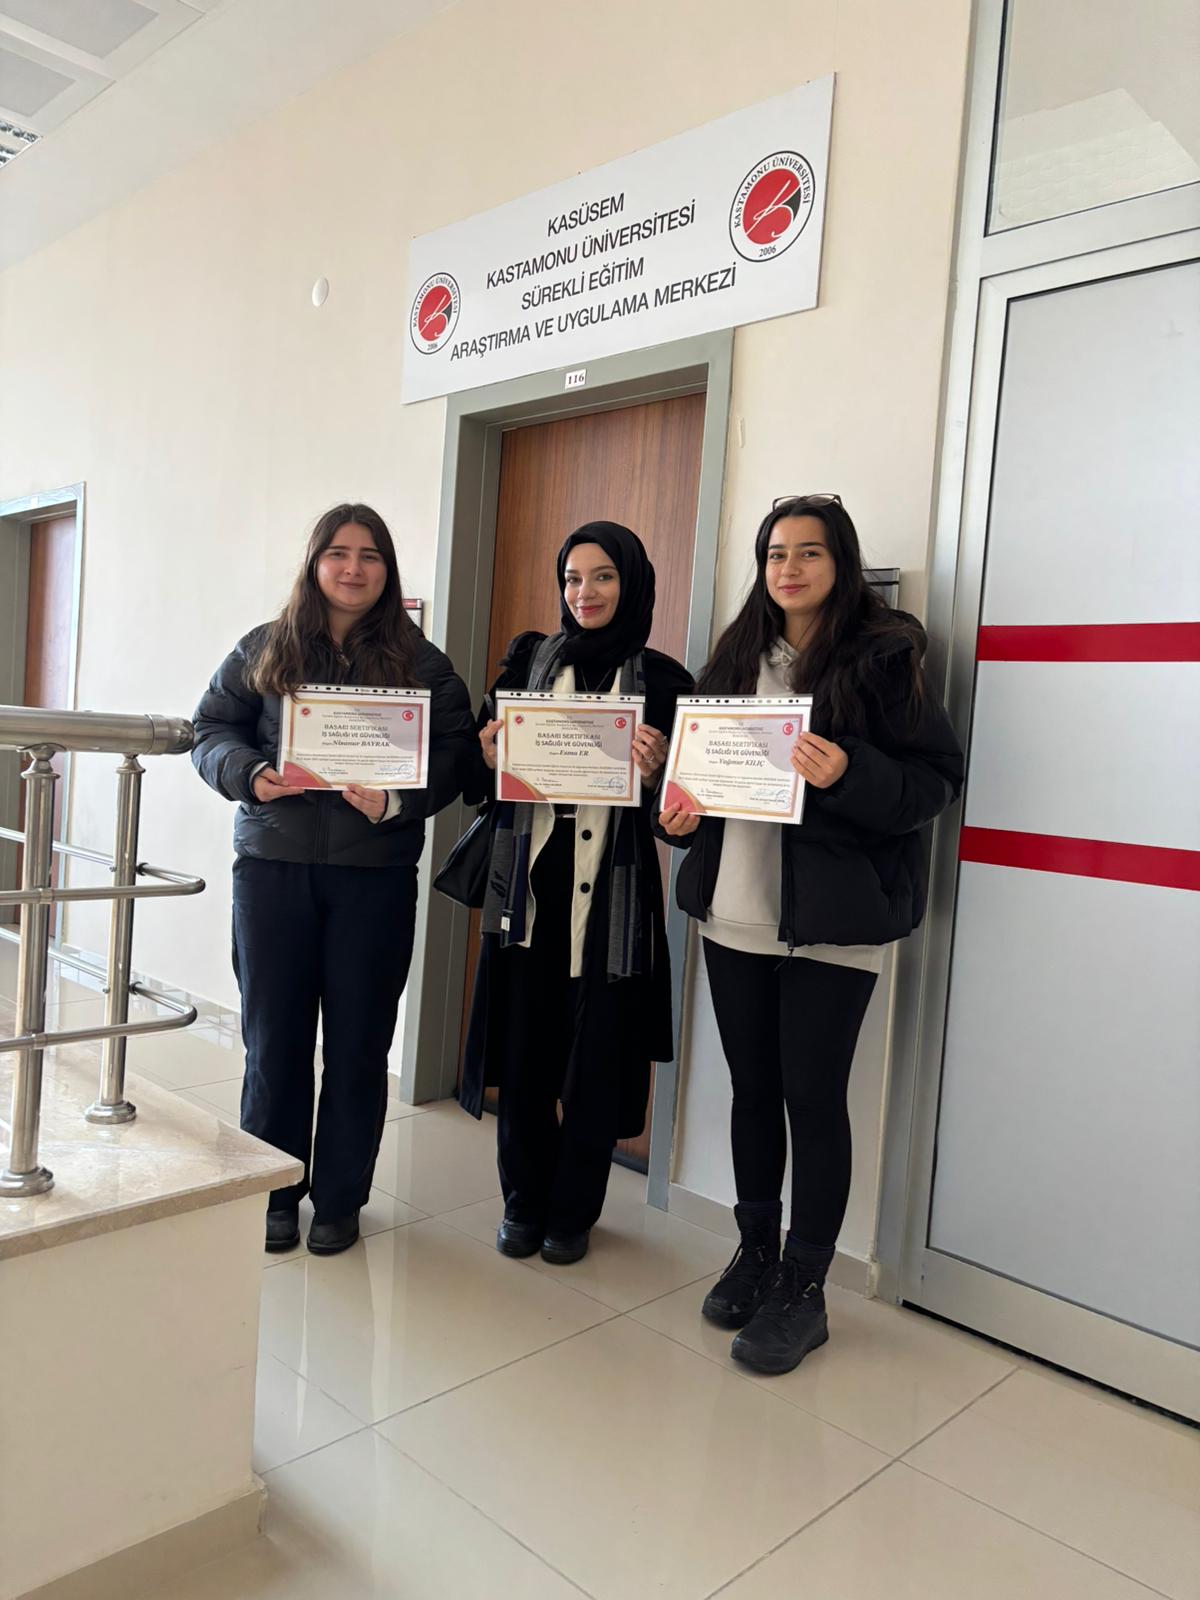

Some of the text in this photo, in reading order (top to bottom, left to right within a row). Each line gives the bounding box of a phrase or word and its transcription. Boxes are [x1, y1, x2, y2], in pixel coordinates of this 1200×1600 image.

[547, 193, 625, 237] KASÜSEM
[734, 162, 771, 228] KASTAMONU
[486, 199, 696, 289] KASTAMONU ÜNİVERSİTESİ
[758, 245, 777, 257] 2006
[521, 257, 645, 310] SÜREKLİ EĞİTİM
[450, 262, 737, 361] ARAŞTIRMA VE UYGULAMA MERKEZİ
[567, 373, 585, 385] 116
[360, 740, 390, 748] BAYRAK
